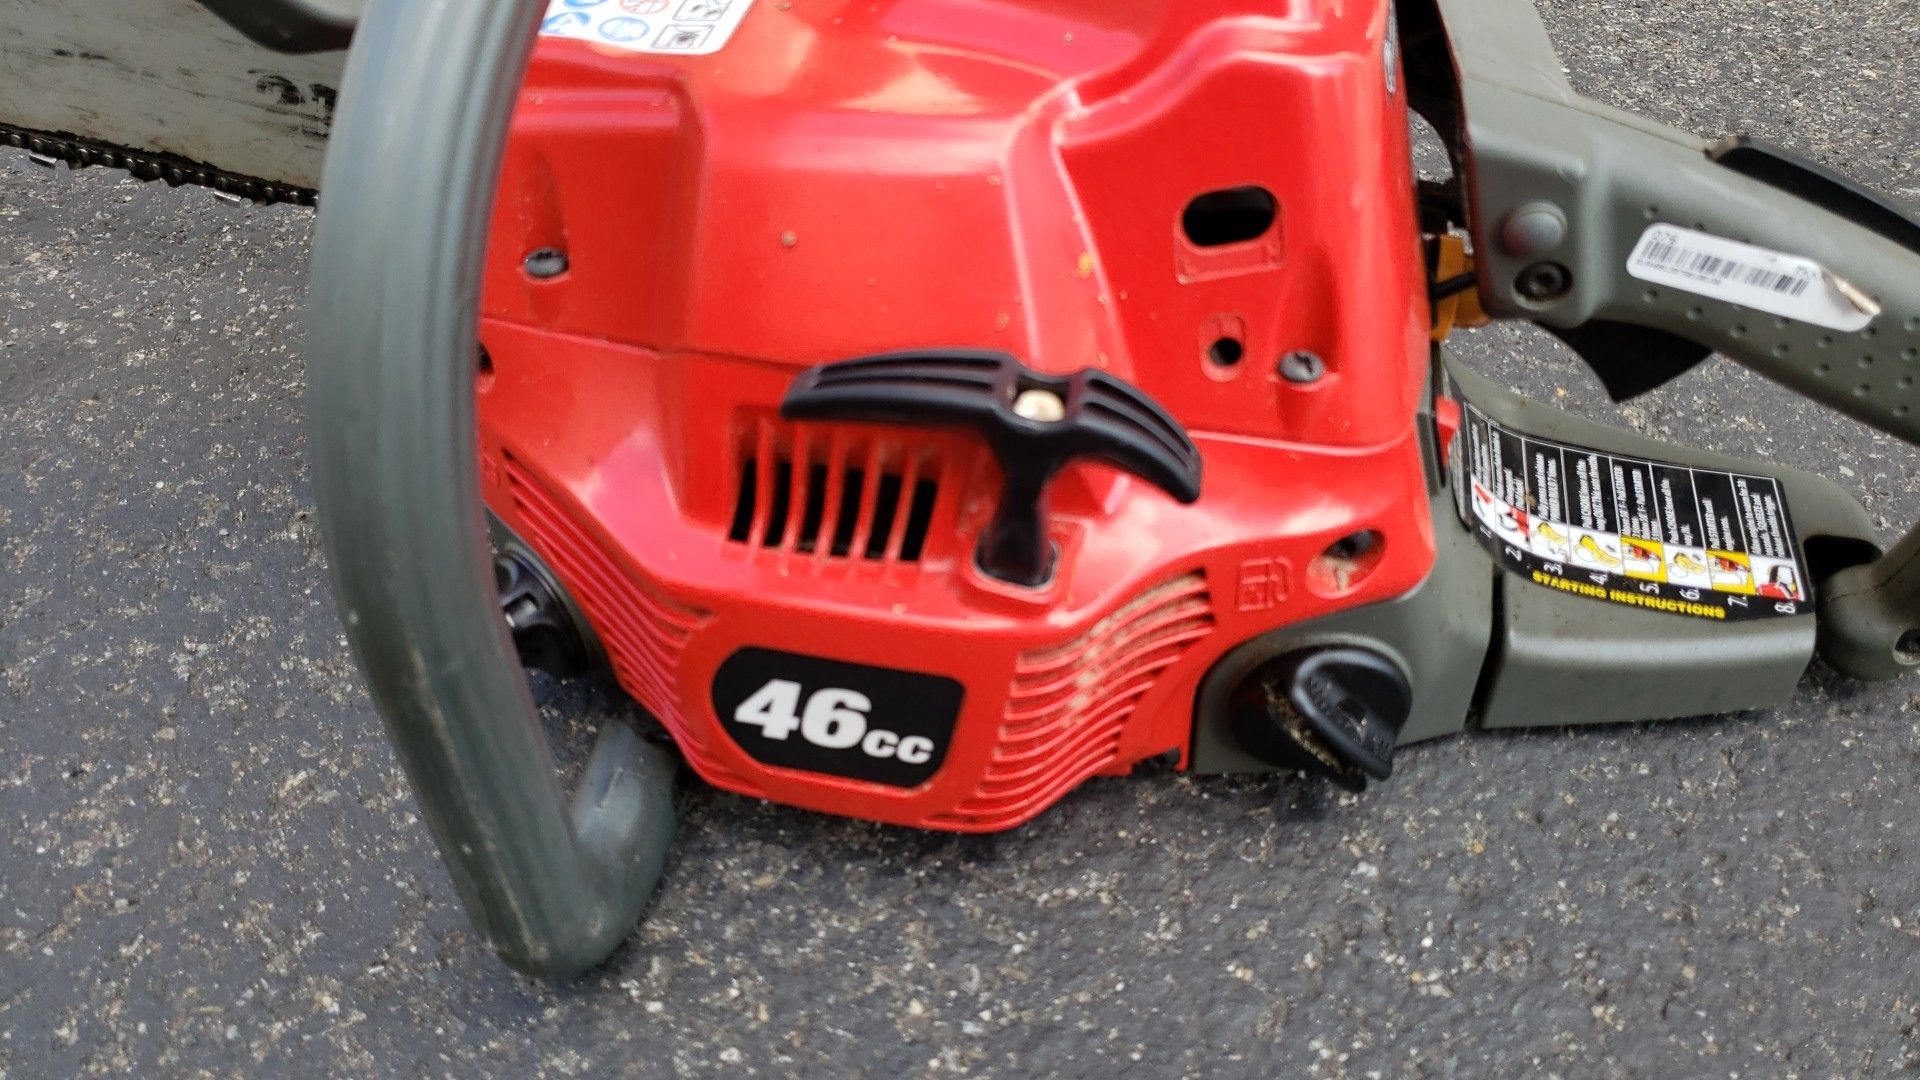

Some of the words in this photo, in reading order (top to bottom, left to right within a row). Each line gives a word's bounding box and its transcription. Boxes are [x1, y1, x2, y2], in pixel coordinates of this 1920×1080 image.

[1579, 495, 1591, 516] CHOKE
[1581, 516, 1592, 528] Pull
[1705, 513, 1719, 537] STARTER
[1709, 537, 1720, 549] Pull
[1532, 570, 1607, 599] STARTING
[1609, 588, 1725, 619] INSTRUCTIONS
[734, 678, 935, 764] 46cc
